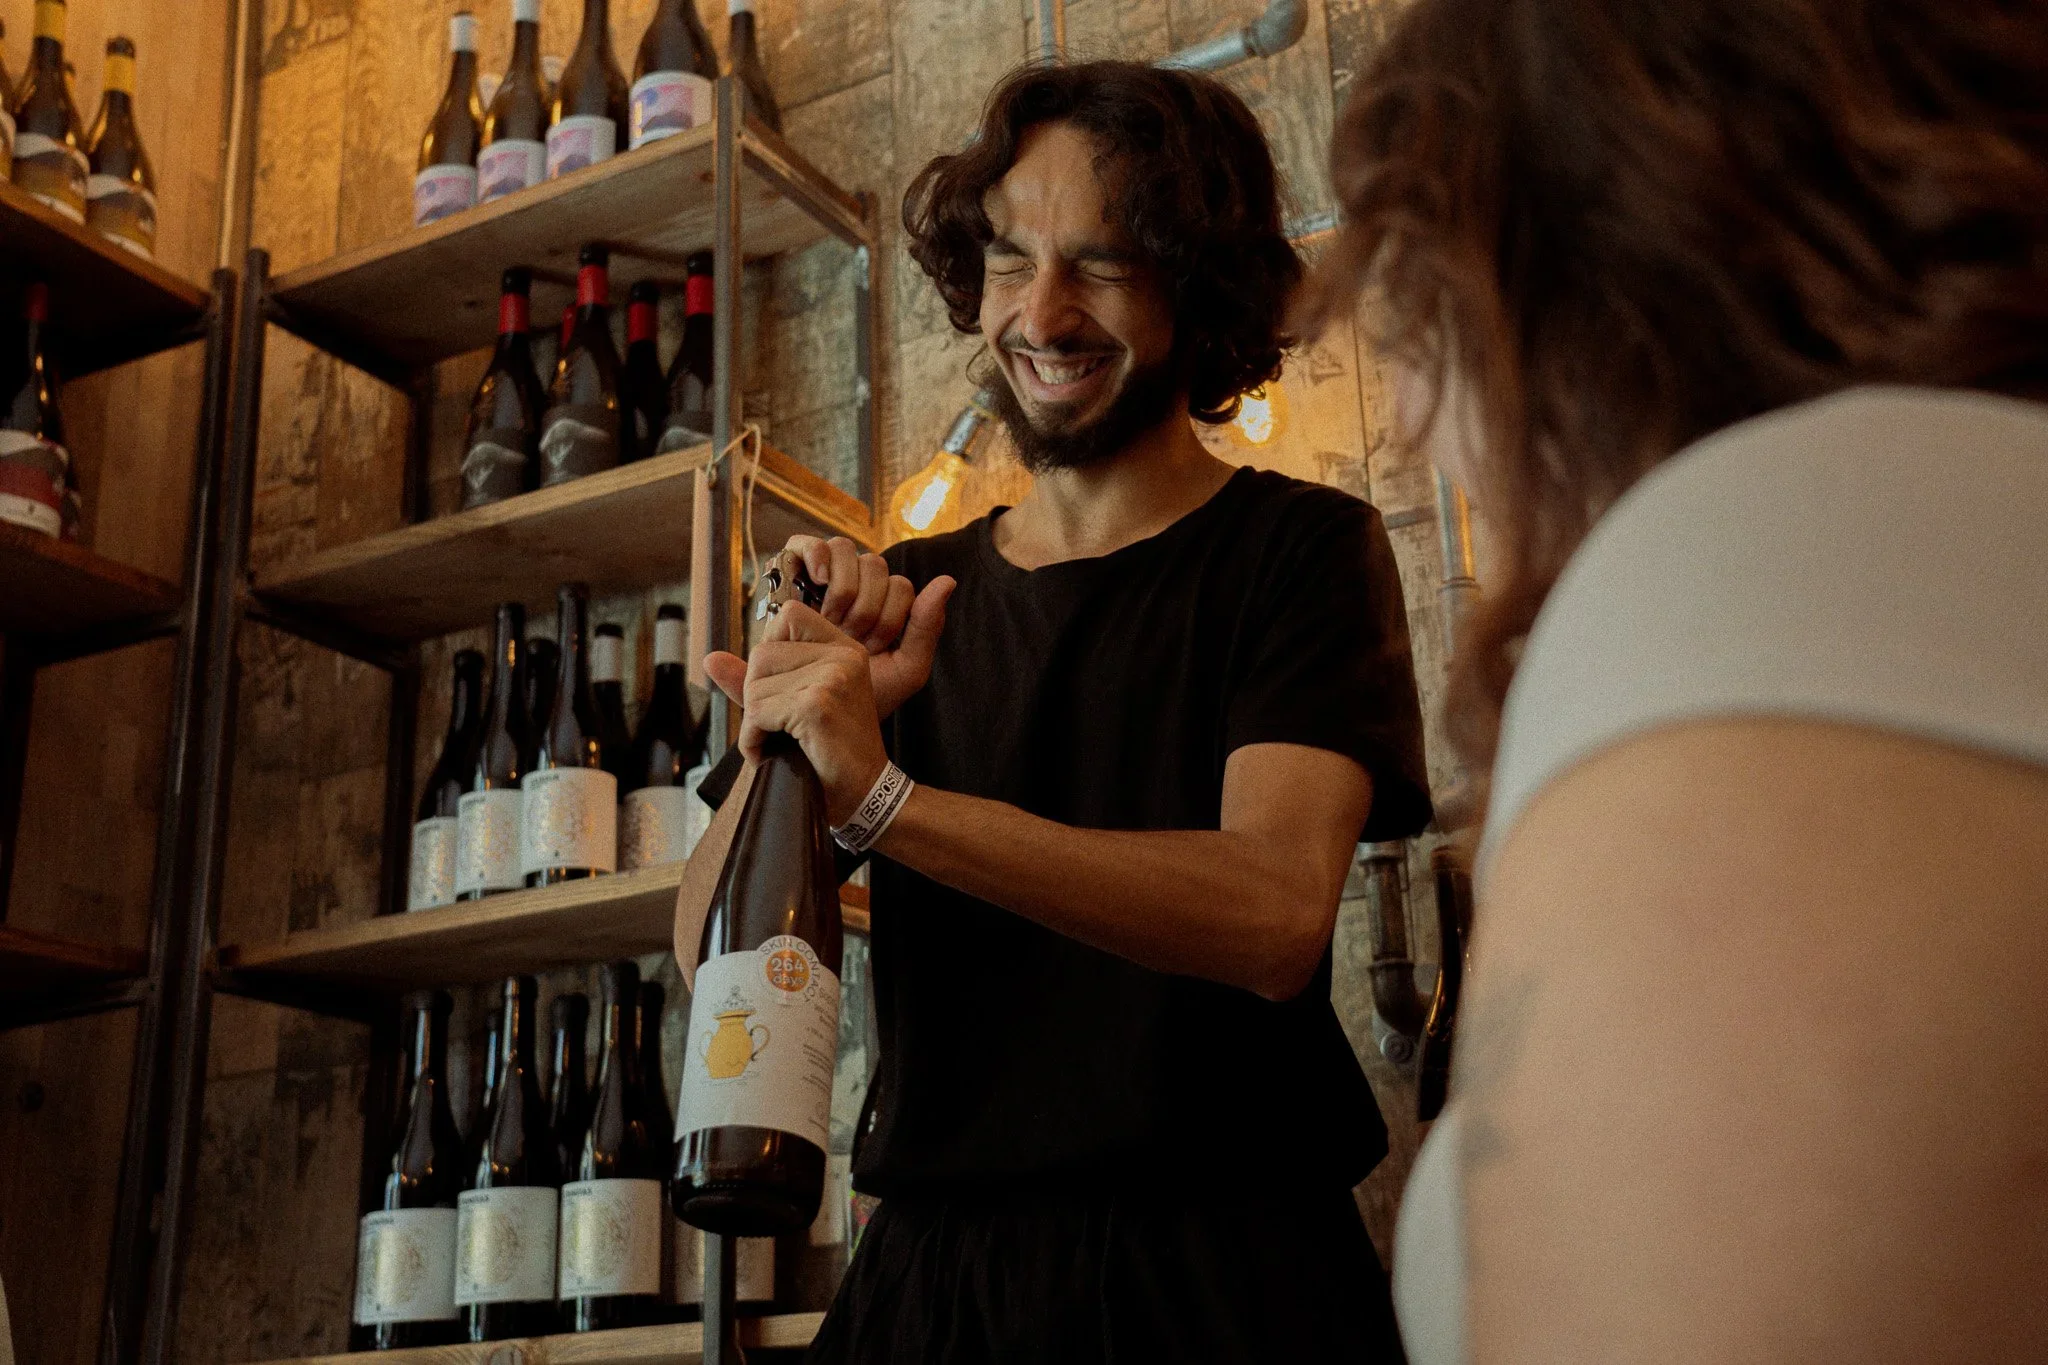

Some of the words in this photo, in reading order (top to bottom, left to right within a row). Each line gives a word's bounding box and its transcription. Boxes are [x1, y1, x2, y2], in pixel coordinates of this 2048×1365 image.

[760, 937, 793, 956] SKIN
[796, 941, 822, 1003] CONTACT
[771, 957, 804, 973] 264
[772, 974, 805, 987] days
